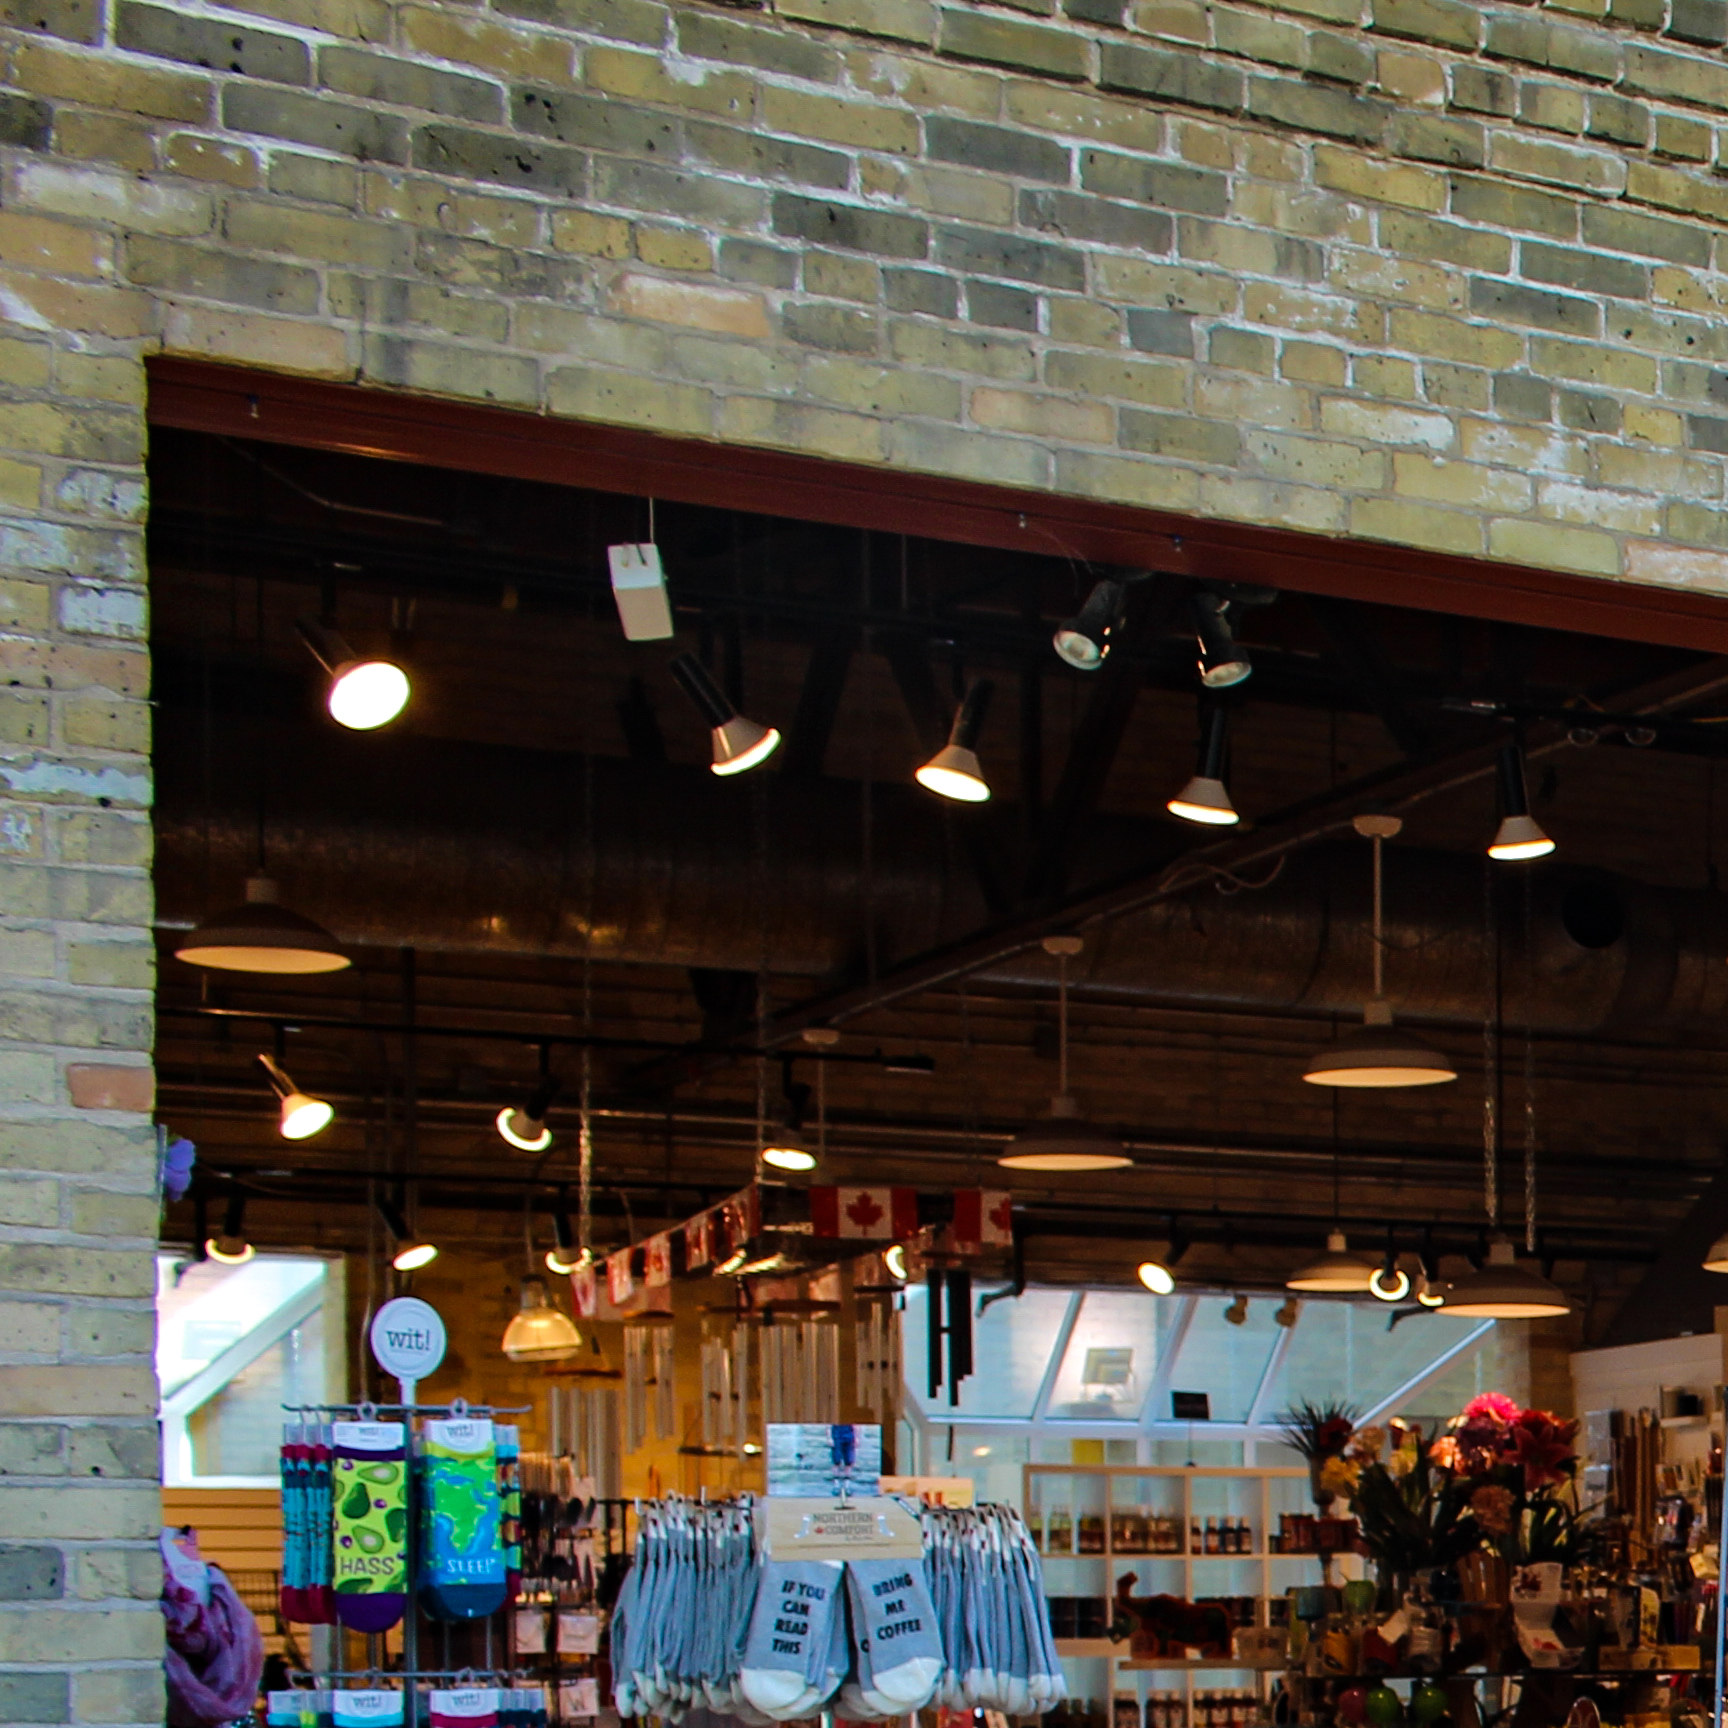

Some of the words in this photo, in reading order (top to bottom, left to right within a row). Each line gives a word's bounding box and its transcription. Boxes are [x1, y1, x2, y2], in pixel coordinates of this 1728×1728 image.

[386, 1327, 431, 1351] wit!
[446, 1424, 475, 1438] wit!
[813, 1512, 873, 1524] NORTHERN
[340, 1556, 395, 1576] HASS
[781, 1579, 796, 1593] IF
[798, 1581, 826, 1600] YOU
[872, 1573, 913, 1597] BRING
[782, 1600, 810, 1617] CAN
[884, 1599, 906, 1616] ME
[775, 1618, 809, 1636] READ
[877, 1618, 922, 1641] COFFEE
[772, 1638, 802, 1655] THIS
[353, 1693, 382, 1707] wit!
[451, 1692, 480, 1706] wit!
